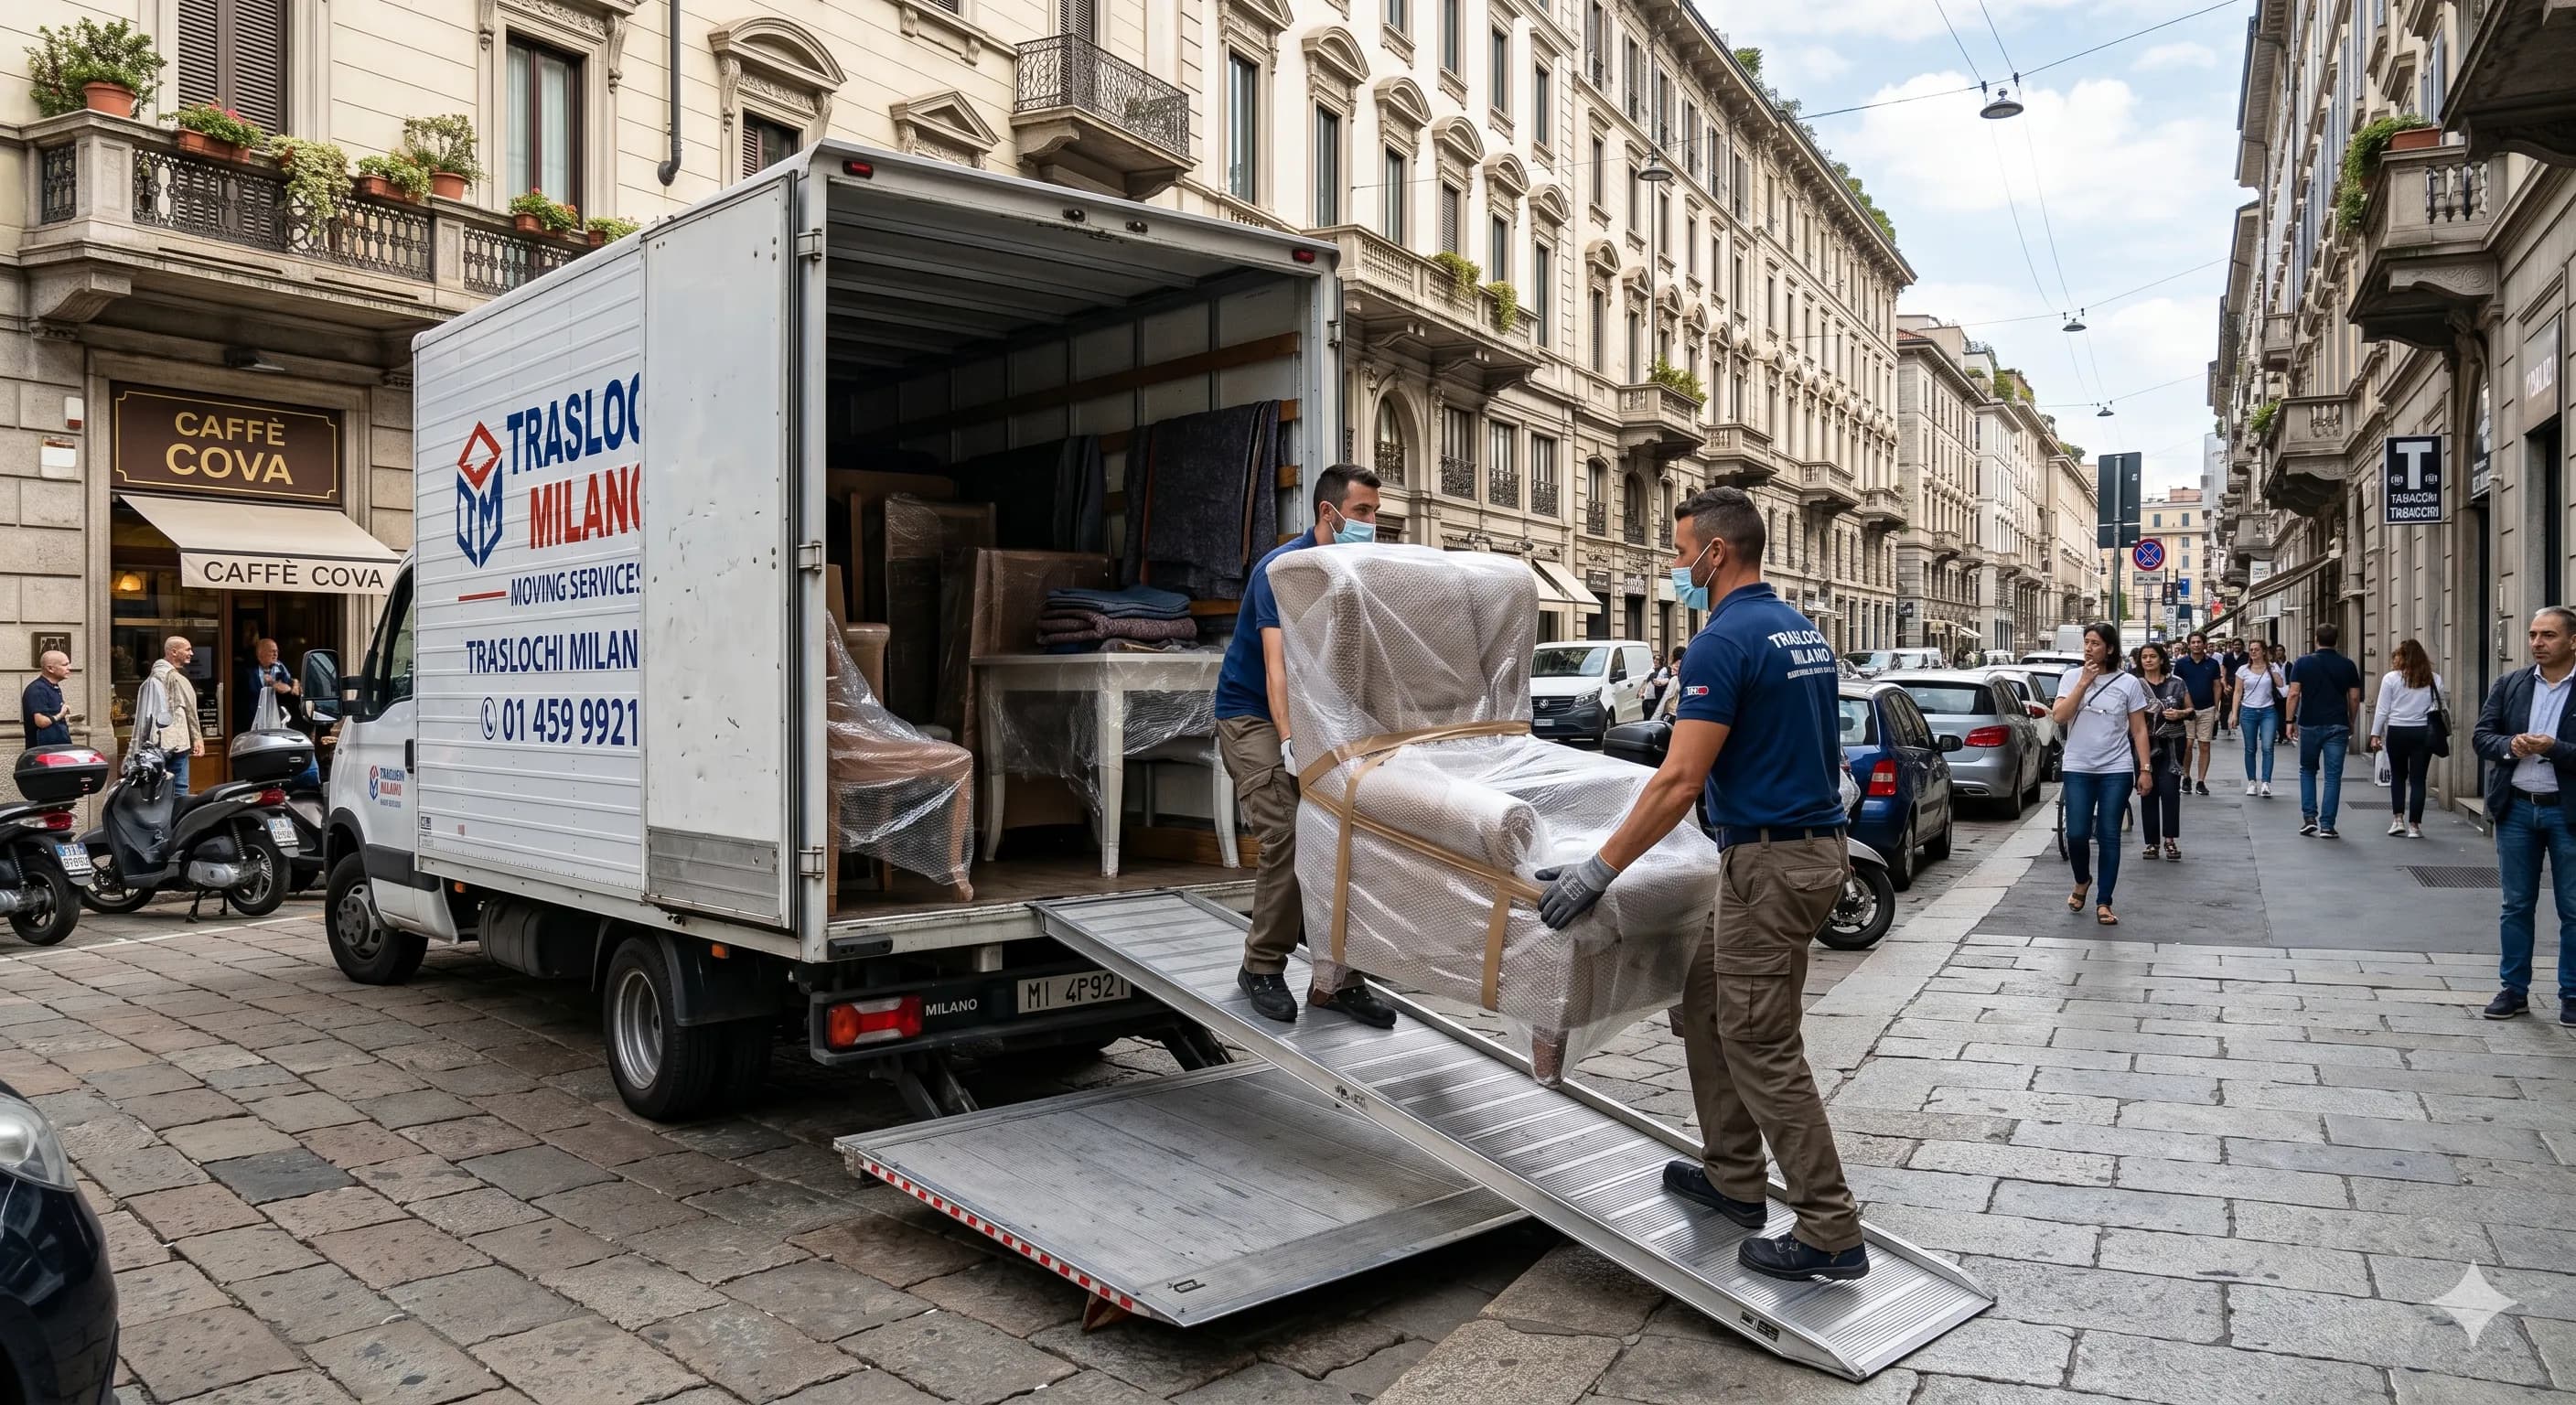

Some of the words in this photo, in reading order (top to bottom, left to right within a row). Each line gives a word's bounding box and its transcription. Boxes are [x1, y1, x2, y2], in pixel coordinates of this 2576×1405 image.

[175, 412, 285, 446] CAFFÈ
[166, 443, 294, 485] COVA
[2396, 441, 2432, 490] T
[203, 559, 299, 585] CAFFÈ
[311, 565, 385, 589] COVA
[510, 572, 566, 606] MOVING
[467, 634, 564, 674] TRASLOCHI
[502, 698, 525, 742] 01
[532, 698, 574, 745] 459
[580, 698, 639, 746] 9921
[925, 998, 978, 1017] MILANO
[1027, 981, 1050, 1010] MI
